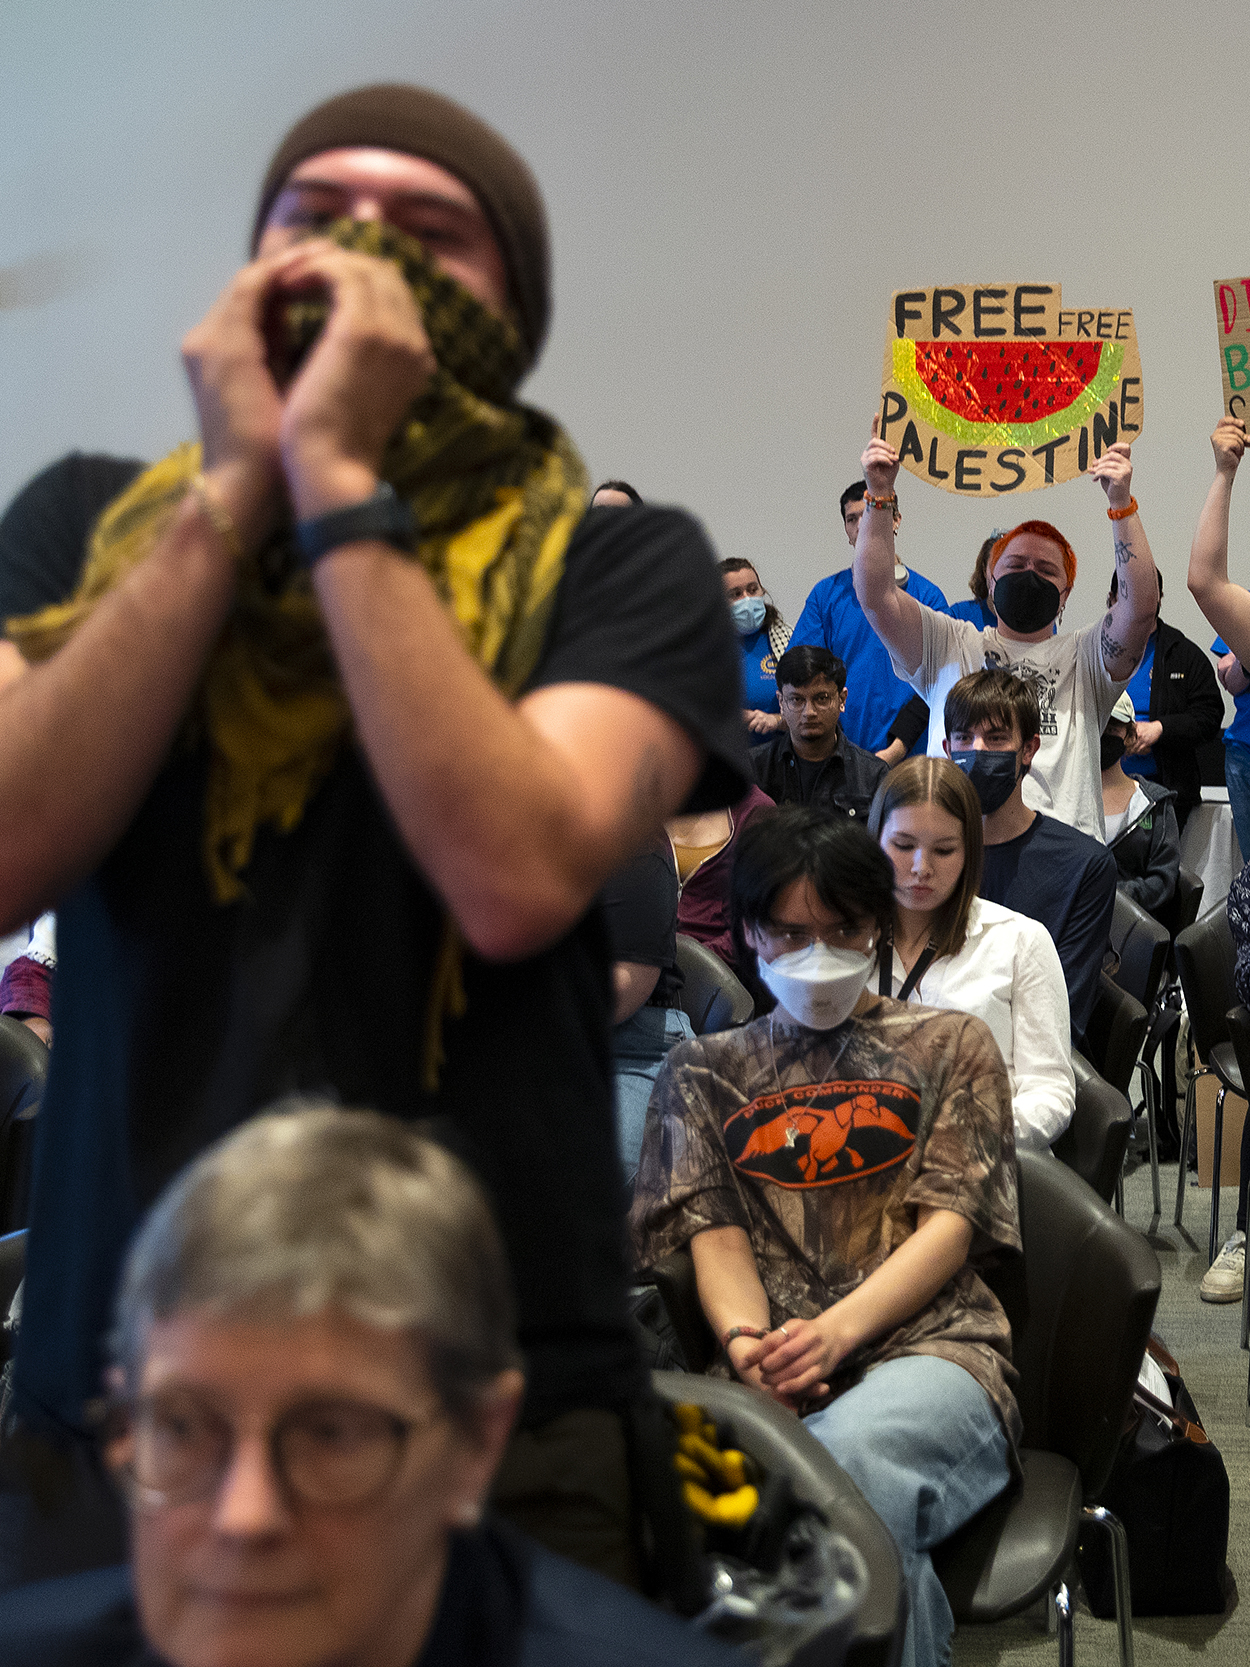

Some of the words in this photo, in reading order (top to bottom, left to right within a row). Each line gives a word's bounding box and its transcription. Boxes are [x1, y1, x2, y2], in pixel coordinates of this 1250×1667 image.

[895, 286, 1053, 338] FREE
[1058, 311, 1132, 340] FREE
[881, 376, 1141, 492] PALESTINE
[793, 1083, 904, 1101] COMMANDER
